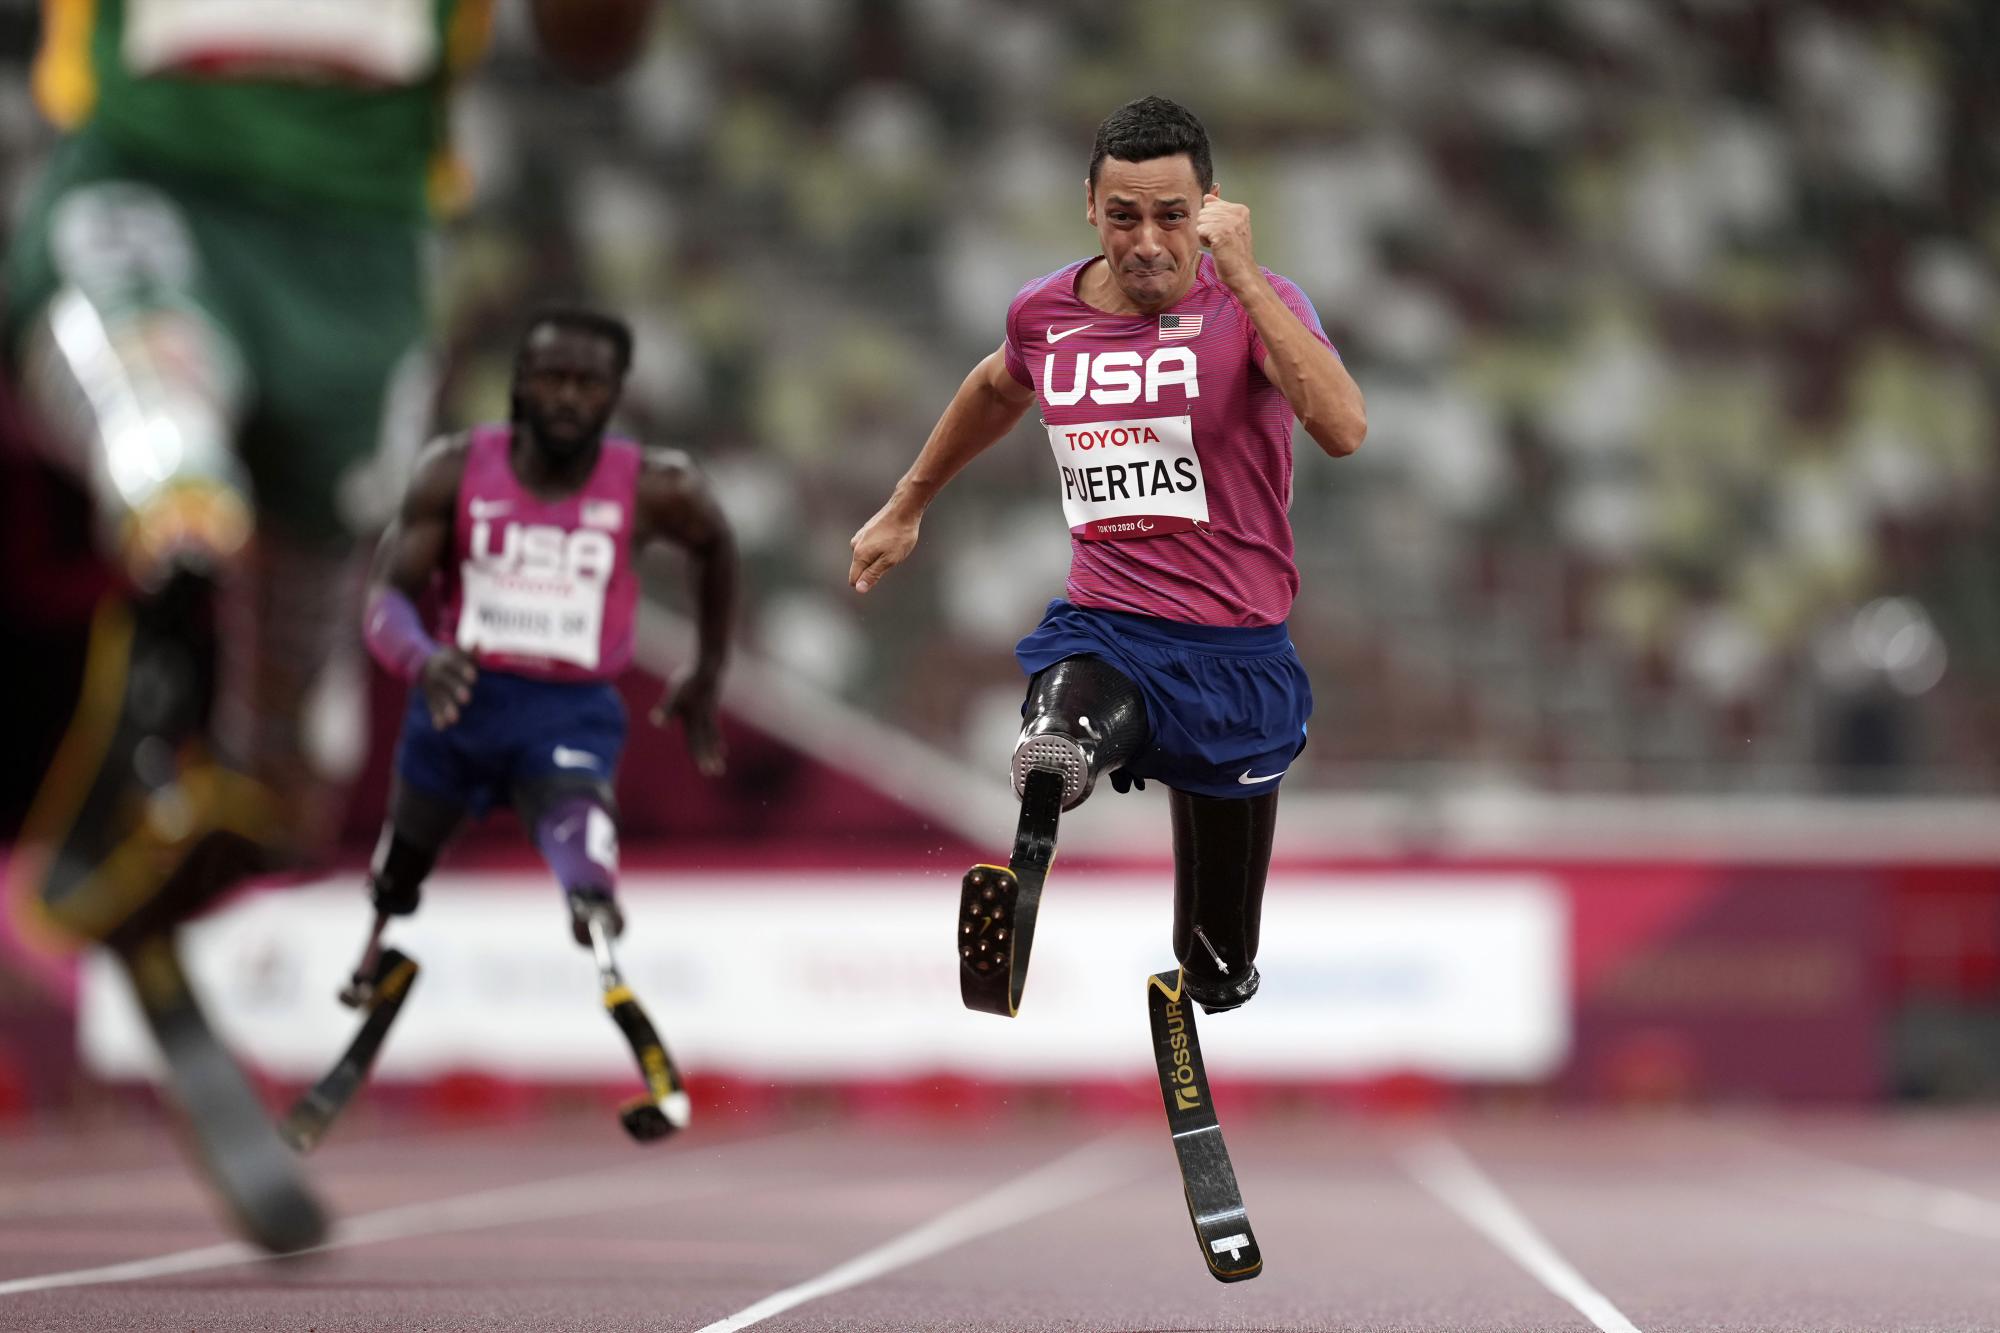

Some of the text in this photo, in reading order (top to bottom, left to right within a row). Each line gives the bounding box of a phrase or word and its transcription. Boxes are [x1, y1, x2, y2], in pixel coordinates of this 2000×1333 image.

[1044, 346, 1200, 406] USA
[1066, 427, 1160, 451] TOYOTA
[1062, 457, 1197, 503] PUERTAS
[1097, 522, 1135, 533] TOKYO 2020
[471, 521, 615, 582] USA
